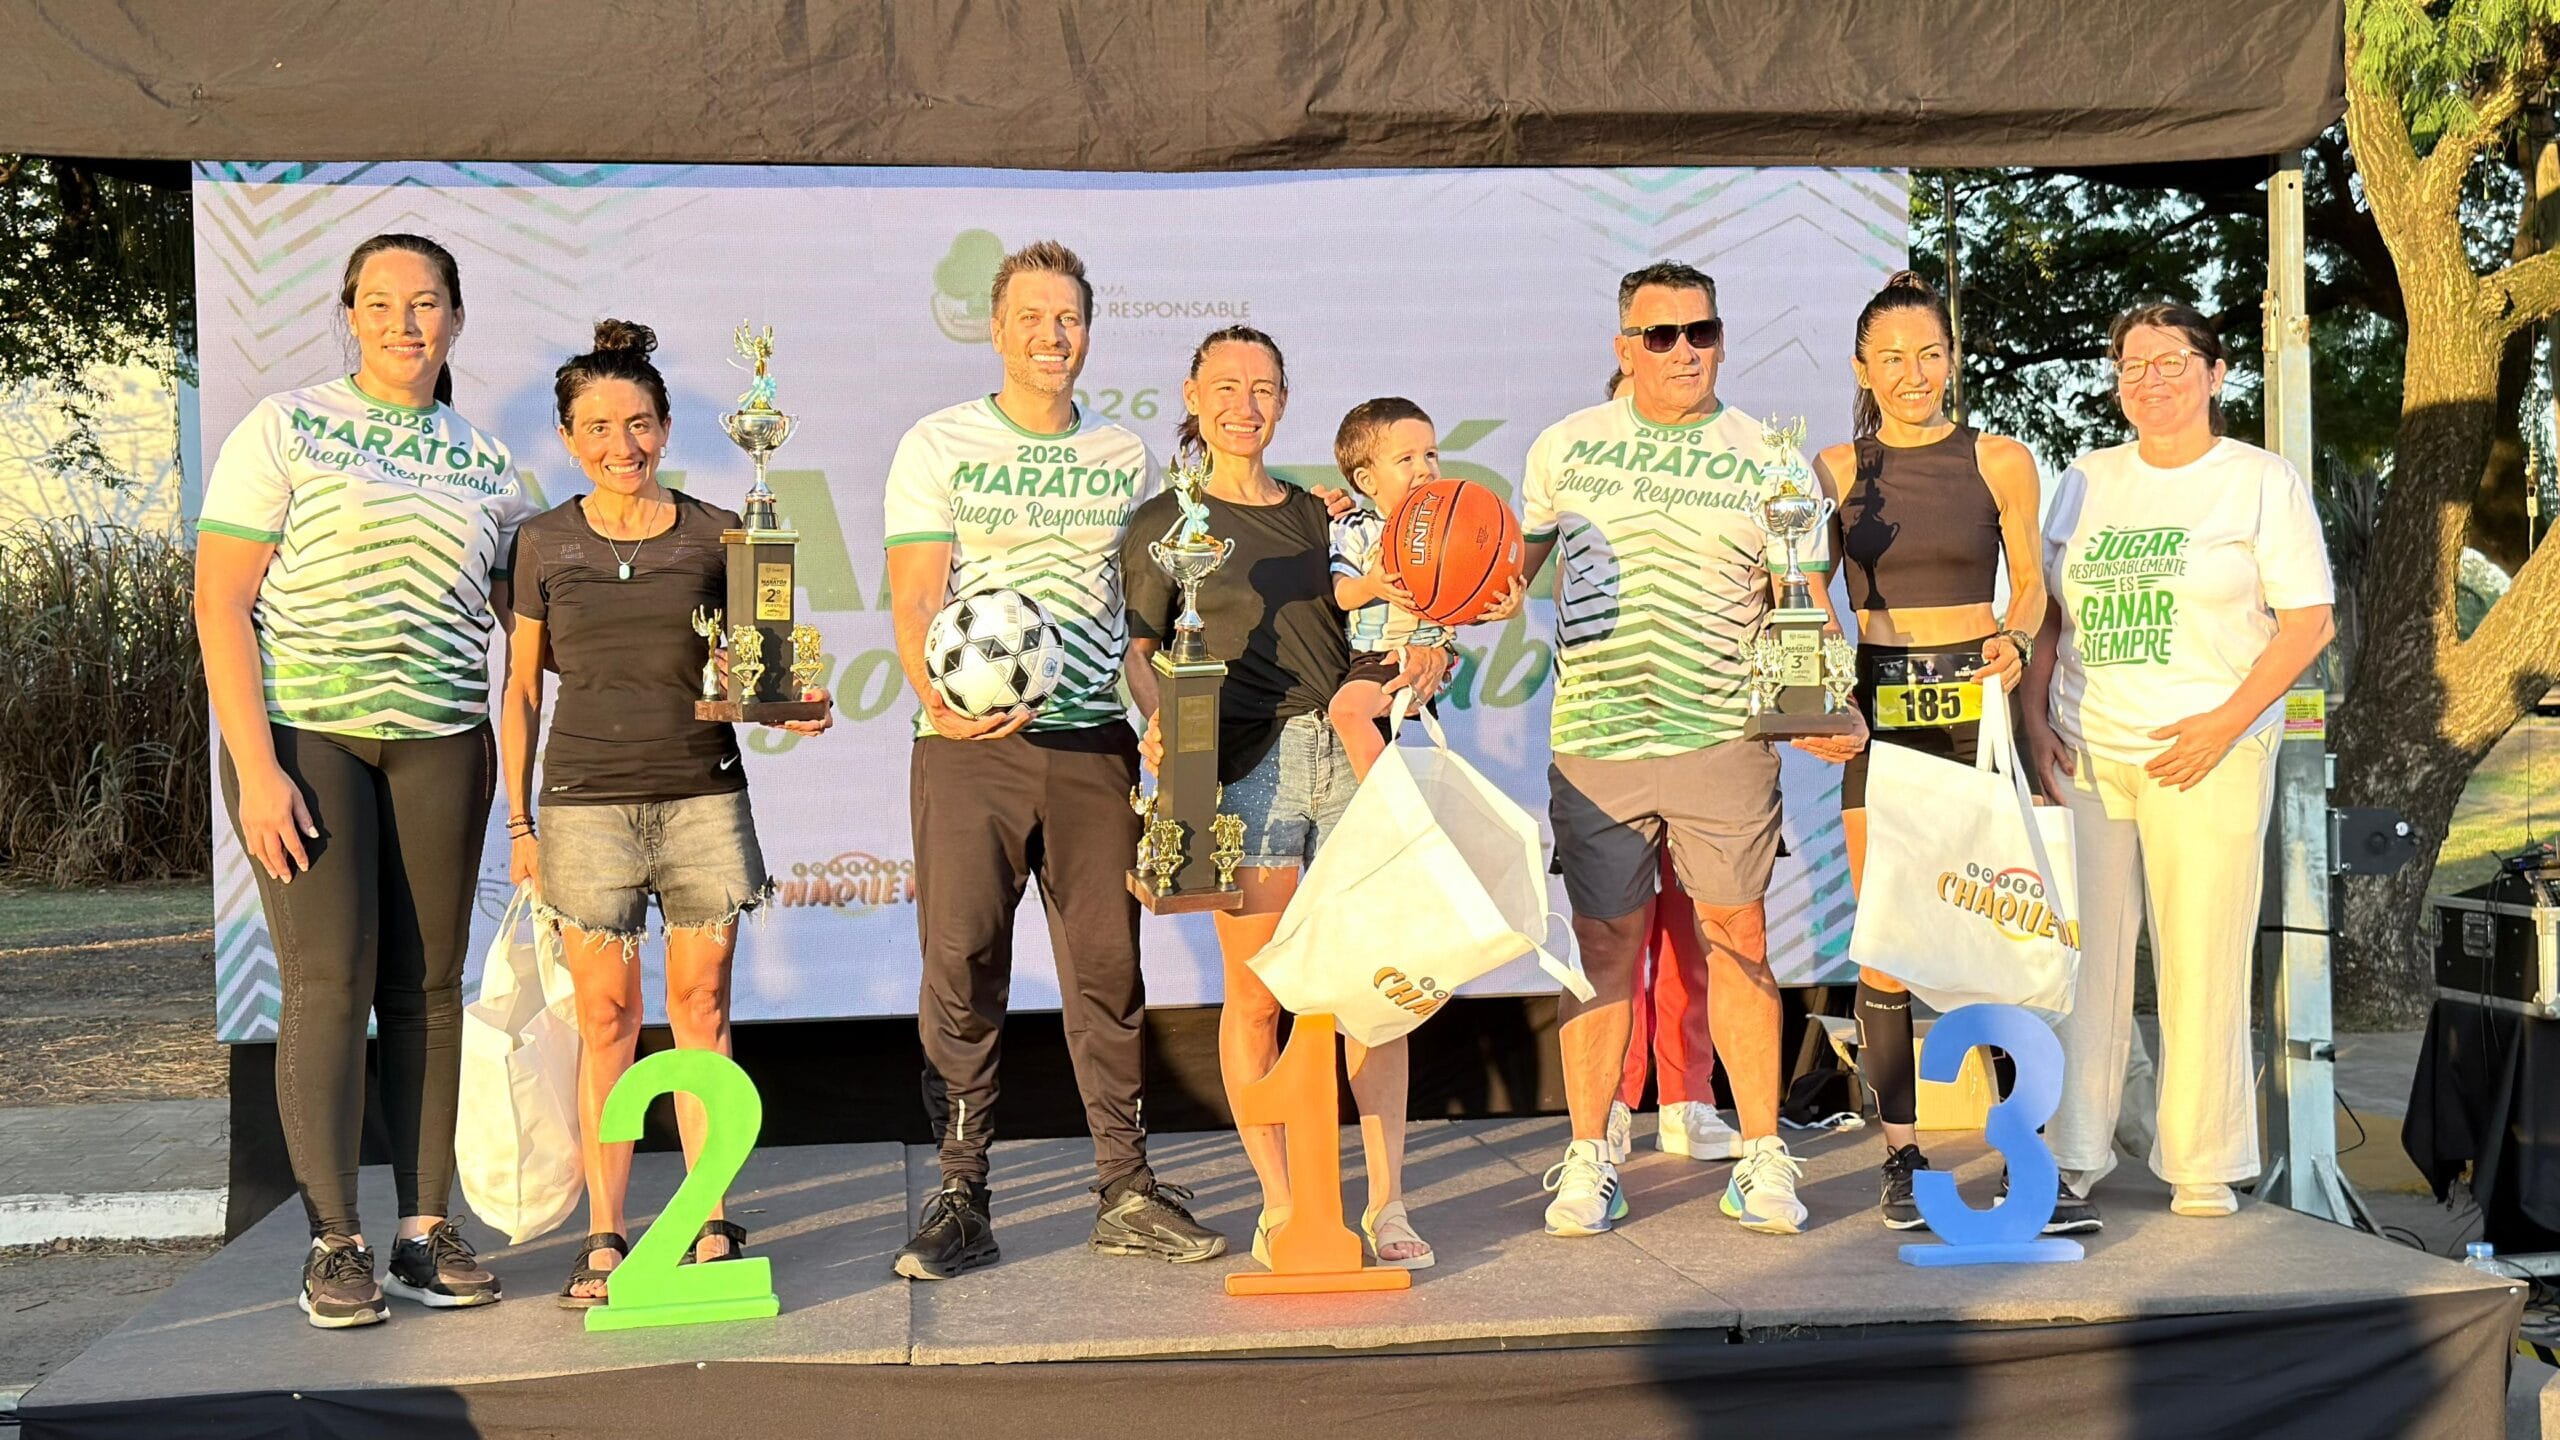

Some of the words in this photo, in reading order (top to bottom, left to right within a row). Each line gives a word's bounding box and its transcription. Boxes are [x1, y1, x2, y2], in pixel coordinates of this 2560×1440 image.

[1108, 301, 1251, 319] RESPONSABLE
[367, 408, 434, 435] 2026
[1634, 427, 1704, 445] 2026
[289, 436, 369, 473] Juego
[291, 408, 506, 476] MARATÓN
[1017, 444, 1078, 464] 2026
[953, 460, 1139, 498] MARATÓN
[1562, 440, 1772, 486] MARATÓN
[1556, 468, 1624, 503] Juego
[1633, 476, 1761, 513] Responsabl
[952, 496, 1018, 535] Juego
[1410, 490, 1440, 567] UNITY
[2084, 530, 2185, 562] JUGAR
[2068, 558, 2188, 580] RESPONSABLEMENTE
[2119, 576, 2135, 592] ES
[2081, 590, 2175, 632] GANAR
[1899, 687, 1962, 722] 185
[1966, 862, 2045, 898] LOTER
[1912, 1002, 2065, 1246] 3
[1240, 1013, 1363, 1273] 1
[599, 1048, 772, 1309] 2
